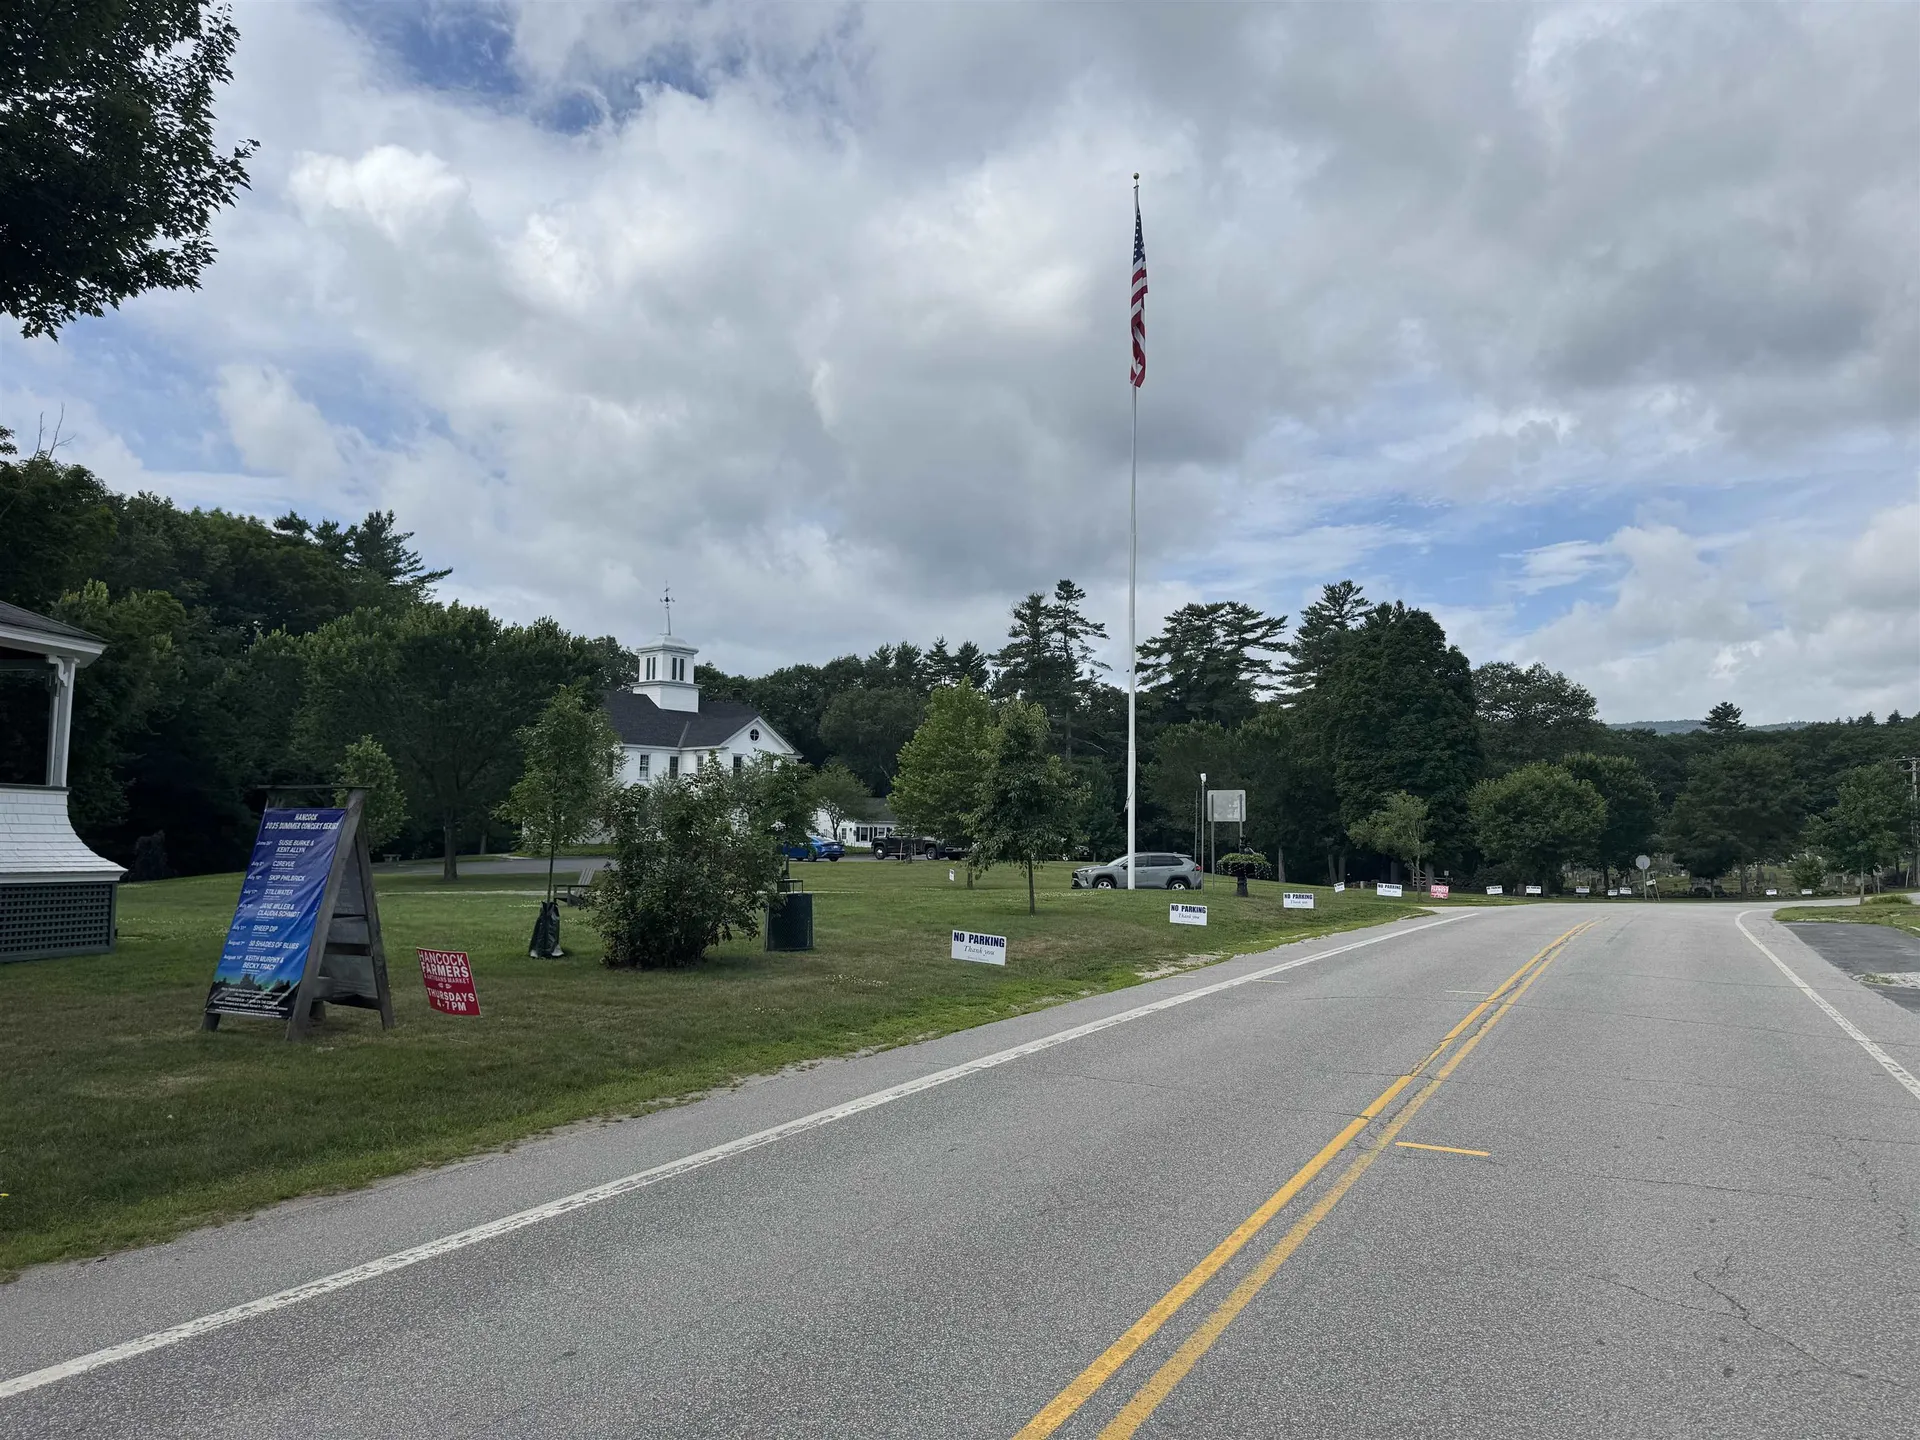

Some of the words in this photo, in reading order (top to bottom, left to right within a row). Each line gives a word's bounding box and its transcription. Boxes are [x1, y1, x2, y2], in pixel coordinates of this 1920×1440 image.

[1181, 905, 1206, 913] PARKING
[954, 932, 965, 942] NO
[969, 934, 1005, 947] PARKING
[964, 946, 982, 954] Thank
[417, 950, 465, 966] HANCOCK
[421, 962, 469, 977] FARMERS
[427, 987, 475, 1002] THURSDAYS
